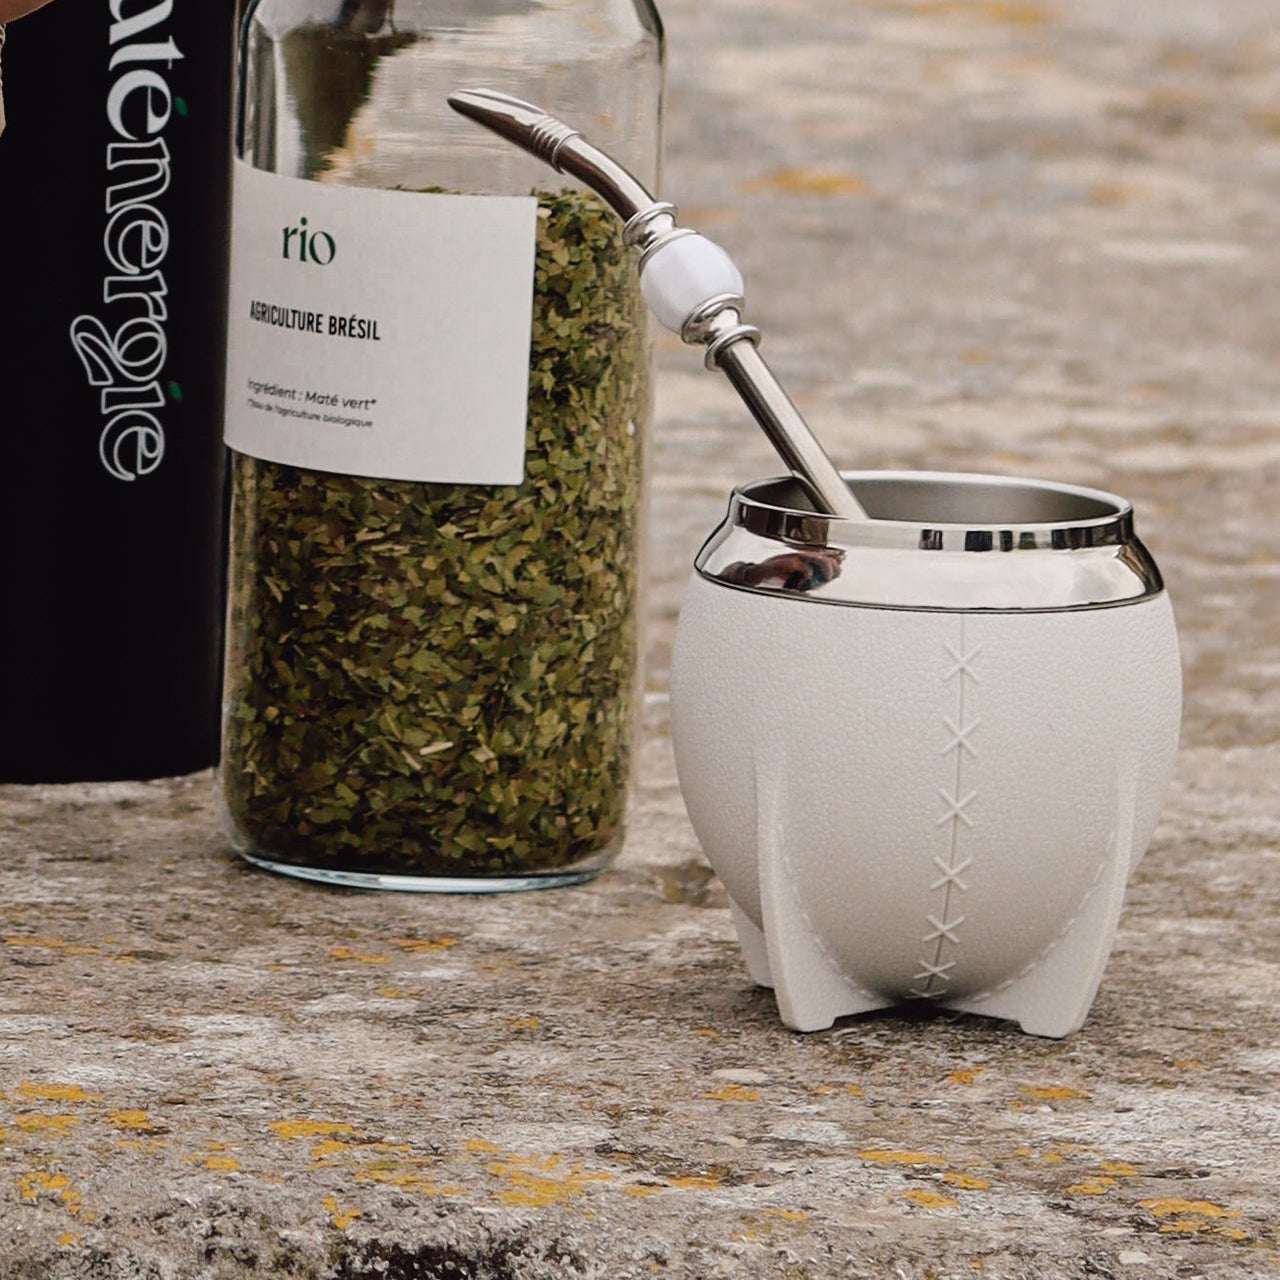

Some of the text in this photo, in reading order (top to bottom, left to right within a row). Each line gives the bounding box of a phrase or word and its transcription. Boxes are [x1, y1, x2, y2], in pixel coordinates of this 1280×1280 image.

[282, 217, 336, 265] rio
[250, 300, 381, 340] AGRICULTURE BRÉSIL
[305, 391, 338, 407] Maté
[323, 414, 373, 427] biologique
